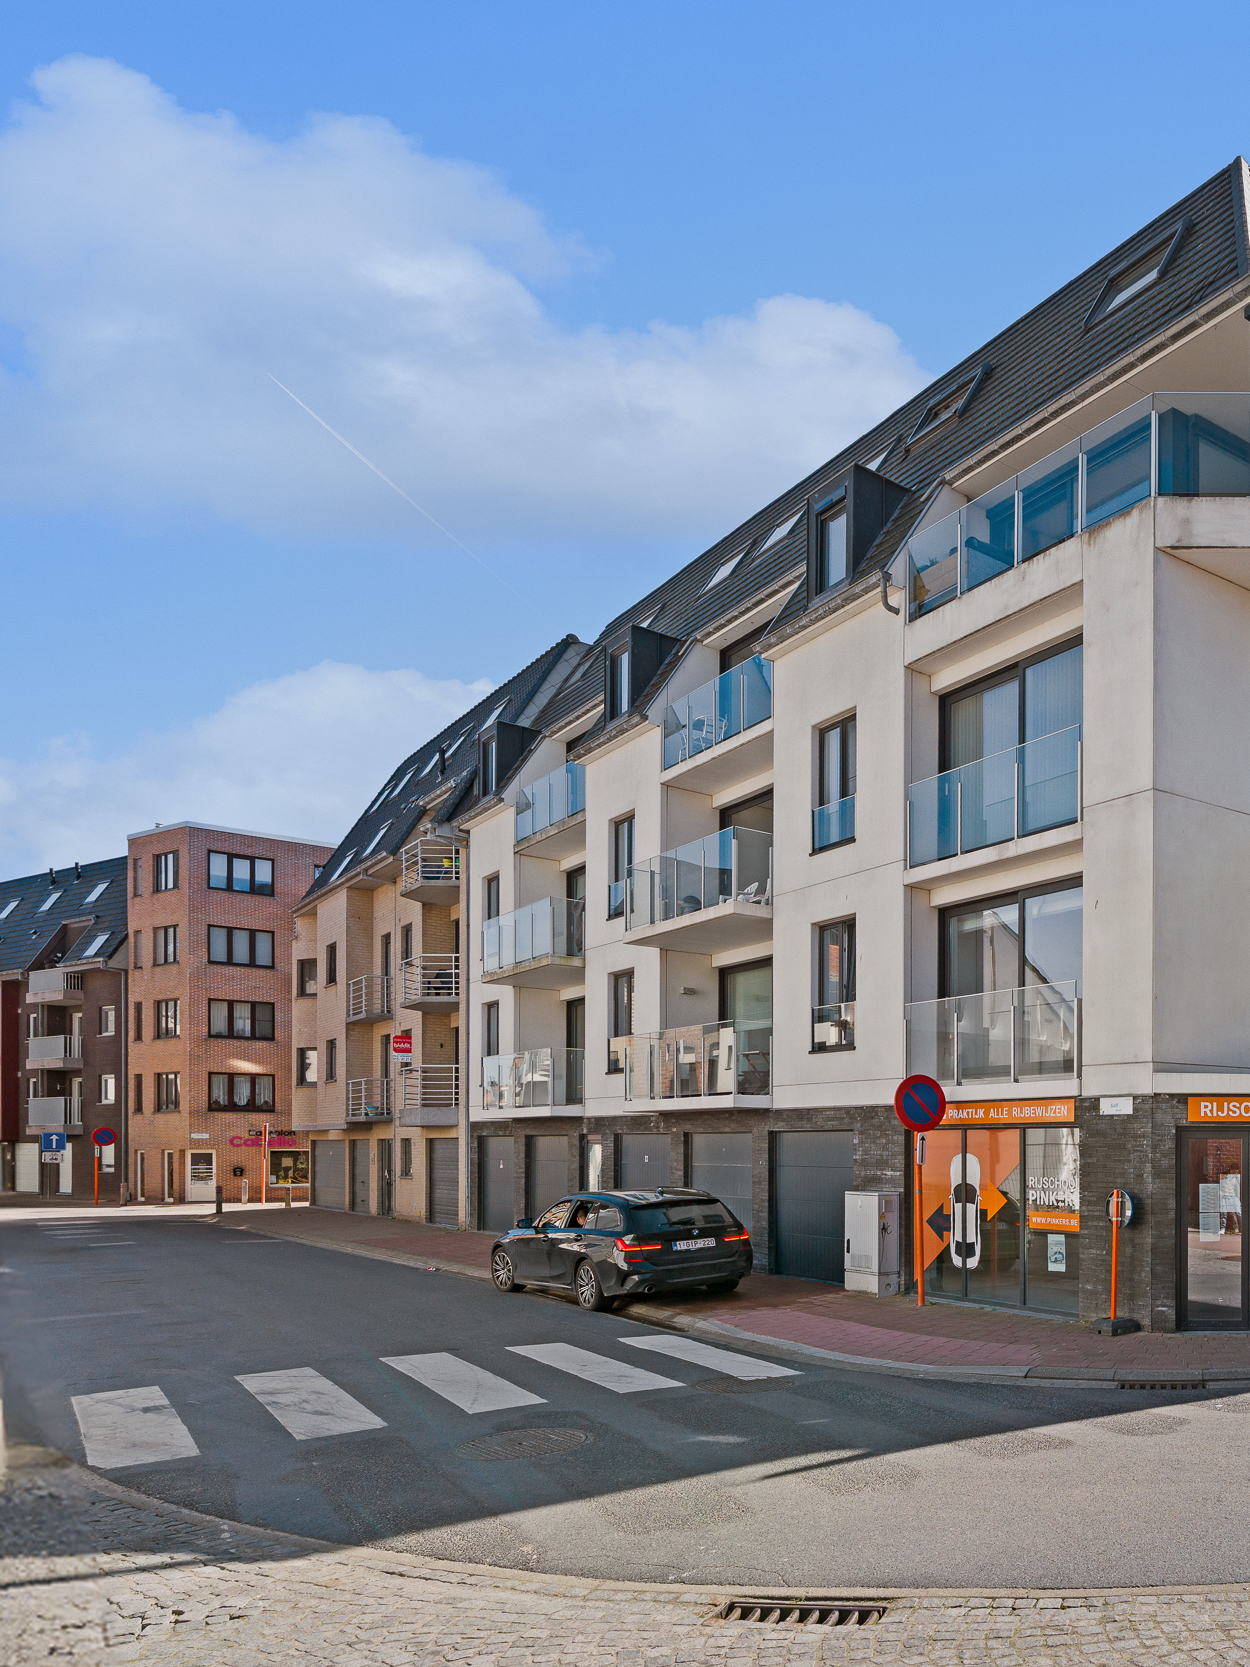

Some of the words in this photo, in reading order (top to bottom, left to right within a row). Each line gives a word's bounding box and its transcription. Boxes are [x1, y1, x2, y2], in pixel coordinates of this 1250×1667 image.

[948, 1108, 985, 1119] PRAKTIJK
[989, 1107, 1008, 1118] ALLE
[1012, 1105, 1068, 1118] RIJBEWIJZEN
[229, 1136, 296, 1147] Cabello
[1032, 1216, 1078, 1226] WWW.PINKERS.BE
